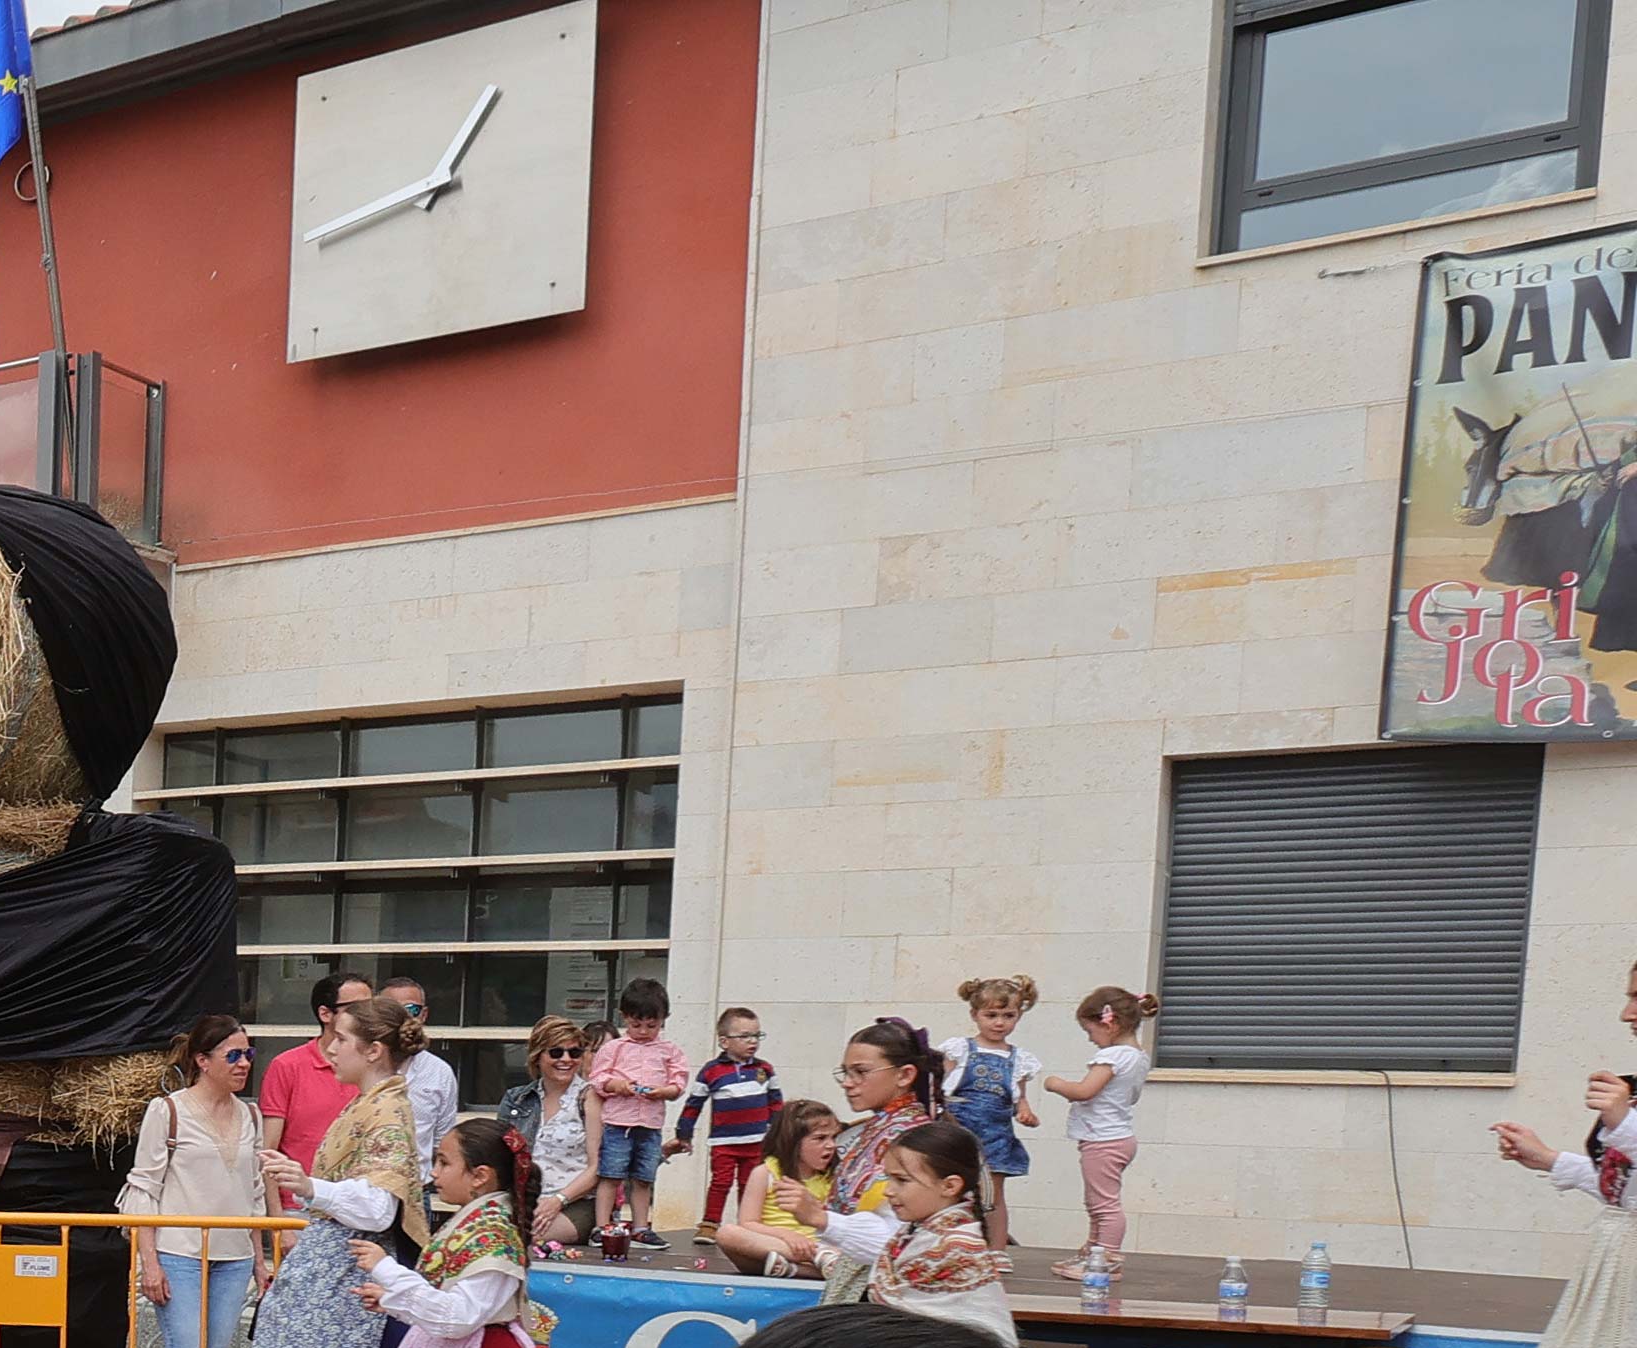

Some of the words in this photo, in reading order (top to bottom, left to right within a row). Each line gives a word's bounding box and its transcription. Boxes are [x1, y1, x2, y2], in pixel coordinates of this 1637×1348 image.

[1442, 261, 1554, 298] Feria
[1435, 271, 1637, 386] PAN
[1407, 570, 1582, 645] Gri
